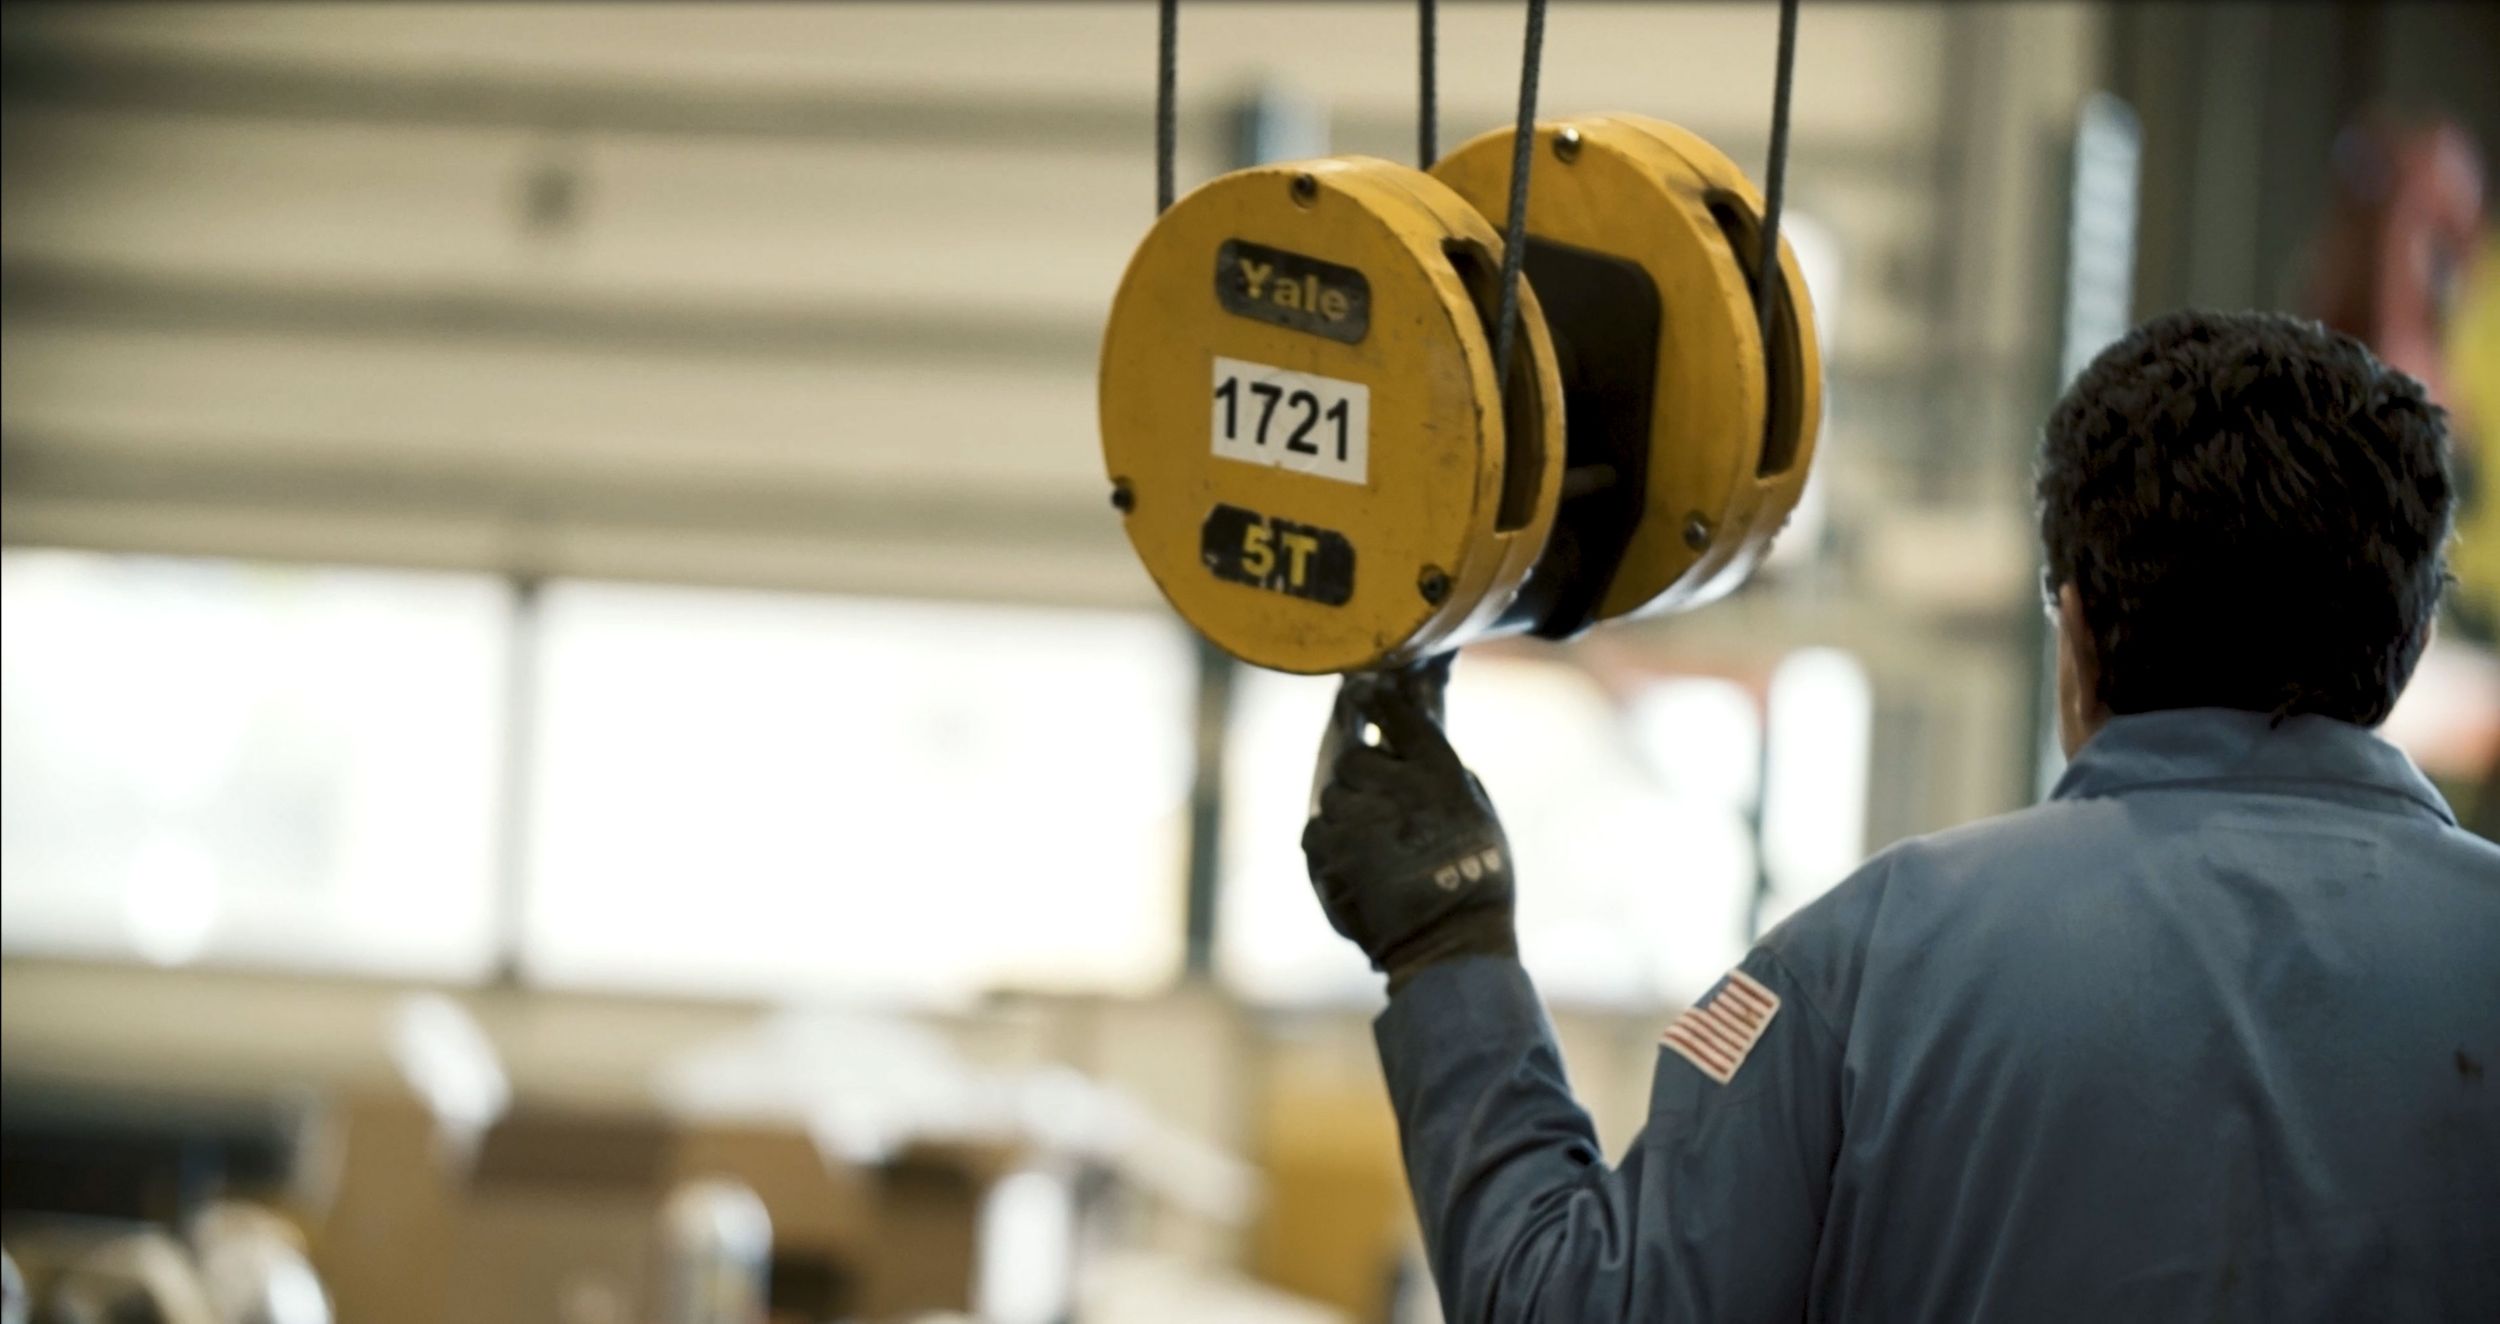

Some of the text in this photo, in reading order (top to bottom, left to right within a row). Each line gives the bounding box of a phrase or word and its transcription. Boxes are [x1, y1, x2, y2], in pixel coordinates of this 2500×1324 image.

[1239, 258, 1349, 322] Yale
[1215, 376, 1349, 462] 1721
[1241, 523, 1318, 587] 5T
